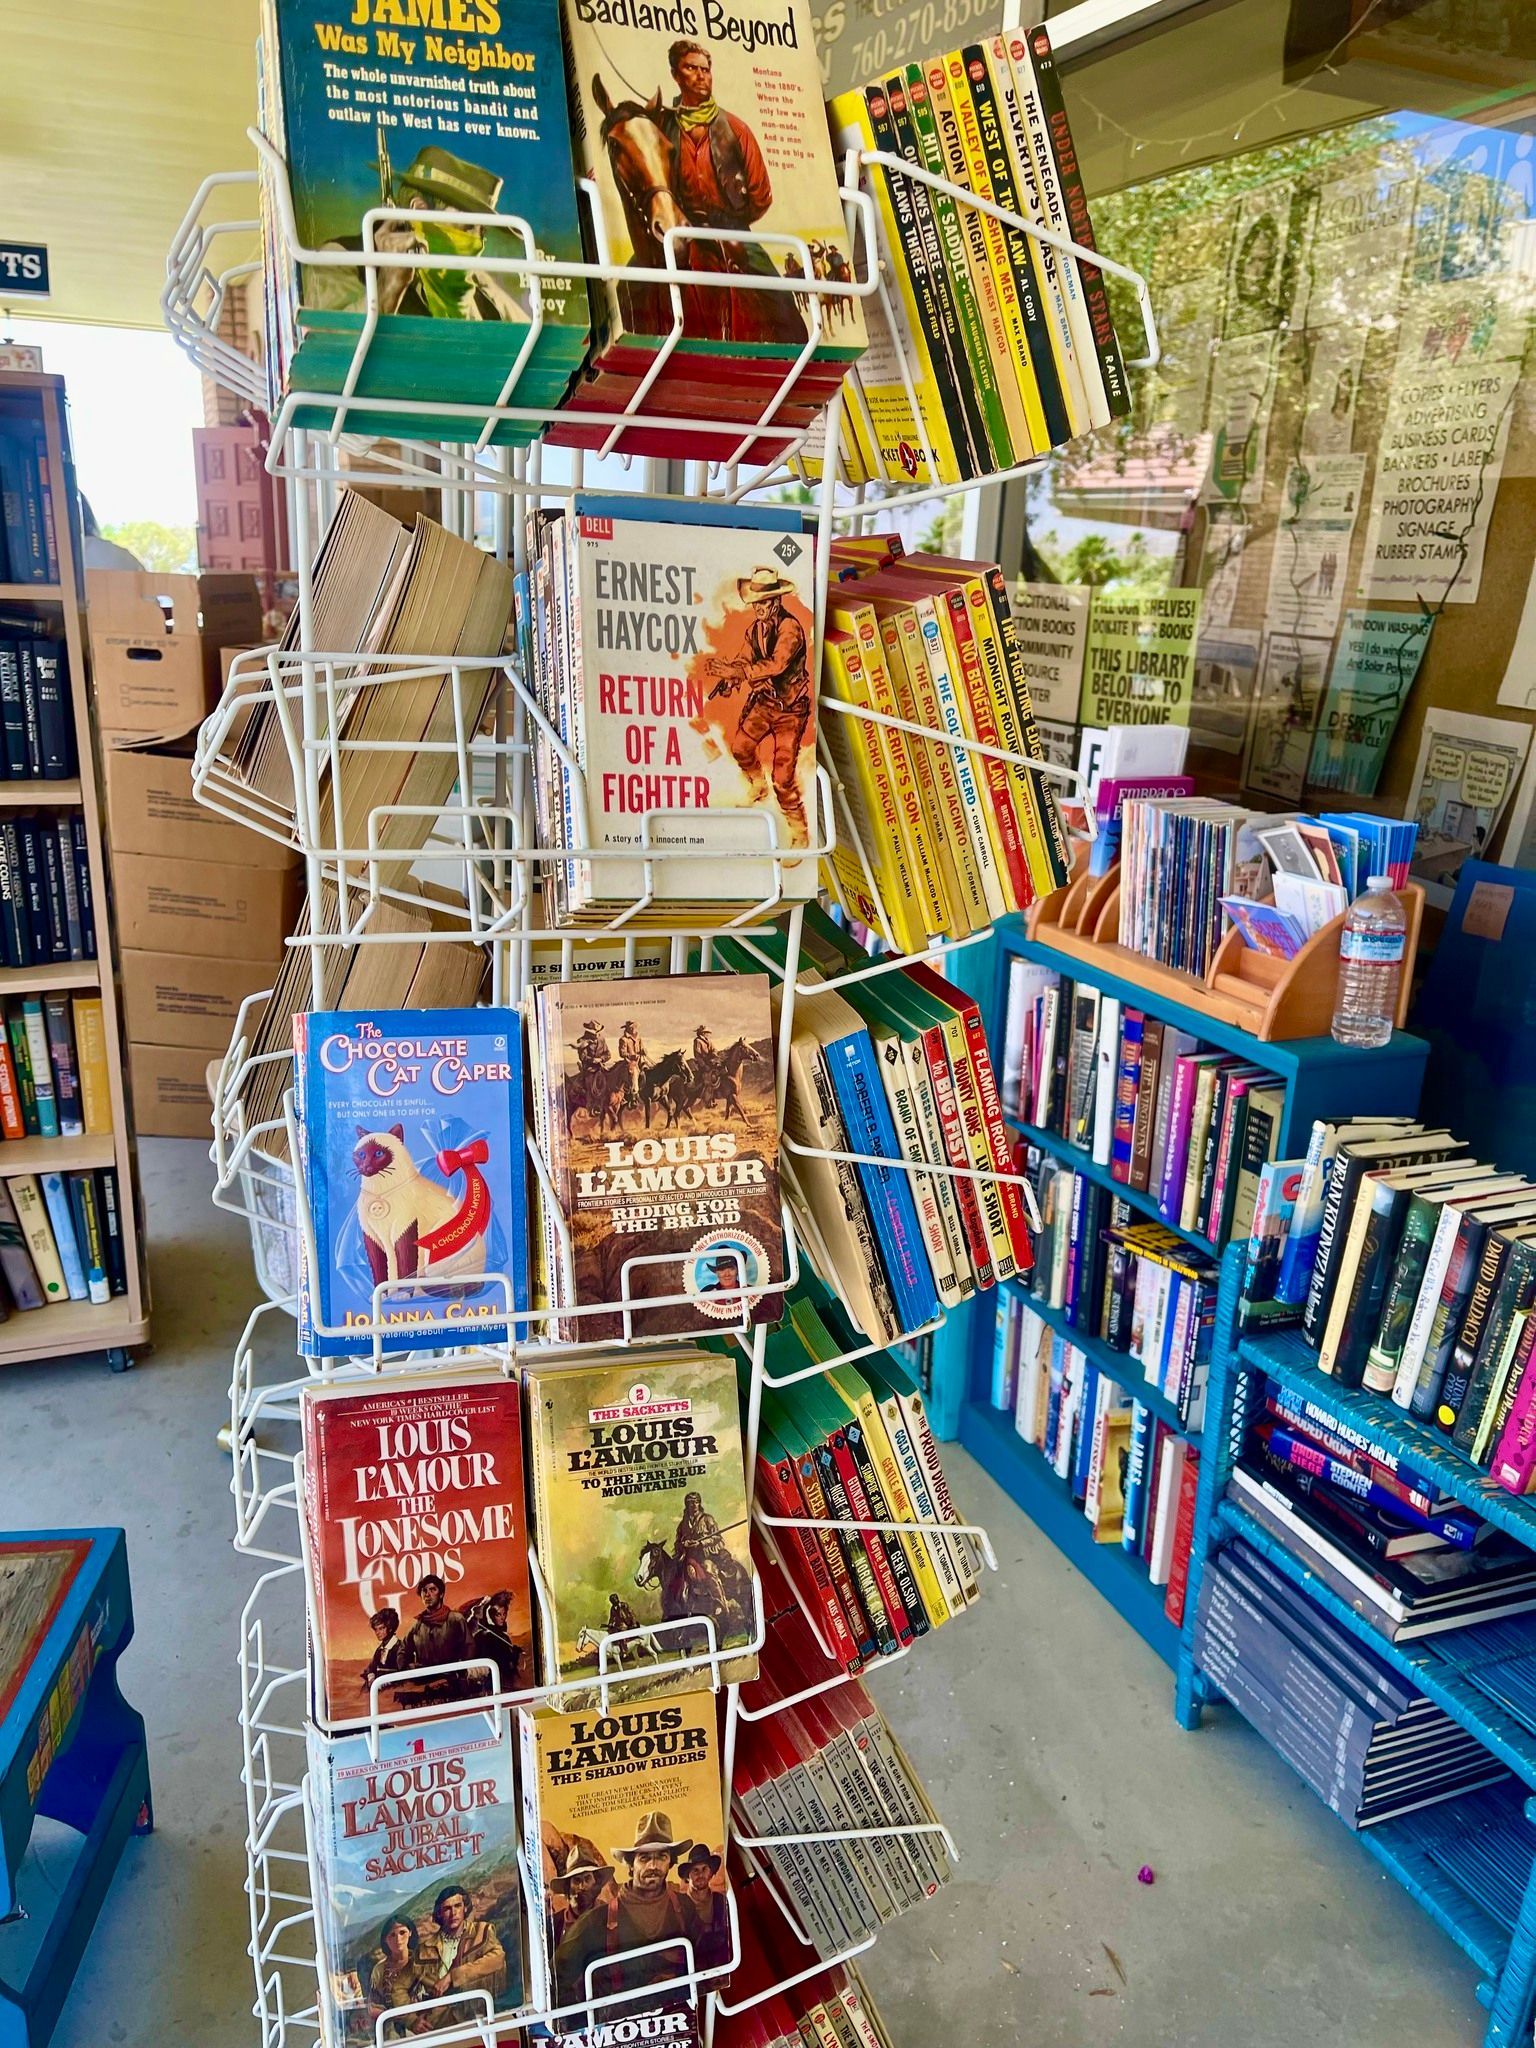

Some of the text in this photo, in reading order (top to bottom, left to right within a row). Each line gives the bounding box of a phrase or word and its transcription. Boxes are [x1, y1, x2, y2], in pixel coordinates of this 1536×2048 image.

[351, 0, 501, 35] JAMES
[576, 0, 798, 53] Badlands Beyond
[314, 24, 536, 72] Was My Neighbor
[323, 63, 536, 99] The whole unvarnished truth about
[753, 67, 782, 77] Montana
[327, 85, 538, 120] the most notorious bandit and
[757, 93, 794, 105] Where the
[328, 107, 541, 141] outlaw the West has ever known.
[959, 100, 980, 156] VALLEY
[979, 101, 1002, 152] WEST
[922, 132, 942, 164] HIT
[939, 110, 966, 175] ACTION
[1023, 90, 1062, 228] THE RENEGADE
[1, 251, 42, 279] TS
[920, 221, 944, 275] THREE
[942, 213, 968, 282] SADDLE
[965, 213, 1008, 356] NIGHT ERNEST HAYCOX
[998, 272, 1015, 304] MEN
[1007, 229, 1037, 322] LAW CODY
[1104, 355, 1122, 398] RAINE
[1401, 377, 1501, 405] COPIES FLYERS
[1404, 403, 1488, 426] ADVERTISING
[1391, 425, 1496, 450] BUSINESS CARDS
[1383, 449, 1495, 472] BANNERS LABELS
[1397, 474, 1471, 494] BROCHURES
[1382, 497, 1478, 516] PHOTOGRAPHY
[586, 517, 611, 535] DELL
[1396, 521, 1456, 538] SIGNAGE
[781, 543, 797, 558] 25¢
[1376, 542, 1469, 560] RUBBER STAMPS
[595, 559, 697, 606] ERNEST
[1142, 598, 1196, 619] SHELVES!
[597, 609, 698, 654] HAYCOX
[1042, 619, 1076, 636] BOOKS
[1092, 619, 1128, 636] DONATE
[1159, 623, 1193, 640] BOOKS
[1350, 619, 1429, 636] WINDOW WASHING
[982, 637, 1008, 708] MIDNIGHT
[1091, 647, 1189, 679] THIS LIBRARY
[600, 674, 704, 718] RETURN
[1162, 680, 1182, 705] TO
[1096, 699, 1171, 725] EVERYONE
[625, 725, 682, 766] OF A
[602, 773, 710, 813] FIGHTER
[876, 773, 896, 827] APACHE
[938, 762, 967, 848] SAN JACINTO
[959, 766, 989, 869] HERD CURT CARROLL
[612, 834, 632, 845] story
[655, 835, 705, 845] innocent man
[0, 862, 12, 901] COLLINS
[355, 1022, 382, 1039] The
[320, 1034, 468, 1073] CHOCOLATE
[367, 1056, 512, 1097] CAT CAPER
[5, 1094, 18, 1129] OPINION
[954, 1057, 981, 1138] BOUNTY GUNS
[974, 1050, 1010, 1167] FLAMING IRONS
[935, 1078, 965, 1164] BIG FIST
[604, 1133, 737, 1168] LOUIS
[576, 1159, 767, 1198] L'AMOUR
[611, 1198, 741, 1222] RIDING FOR
[612, 1211, 741, 1234] THE BRAND
[982, 1197, 1005, 1237] SHORT
[708, 1232, 764, 1258] AUTHORIZED EDITION
[1461, 1238, 1504, 1349] DAVID BALDACCI
[1449, 1375, 1468, 1409] STONE
[350, 1405, 496, 1428] NEW YORK TIMES HARDCOVER LIST
[593, 1401, 690, 1421] THE SACKETTS
[375, 1416, 472, 1461] LOUIS
[589, 1417, 695, 1448] LOUIS
[1305, 1401, 1400, 1472] HOWARD AIRLINE
[567, 1435, 719, 1472] L'AMOUR
[1290, 1453, 1323, 1477] SIEGE
[1291, 1441, 1326, 1467] UNDER
[353, 1451, 501, 1502] L'AMOUR
[581, 1464, 706, 1490] TO THE FAR BLUE
[601, 1478, 688, 1498] MOUNTAINS
[881, 1457, 908, 1514] GENTLE ANNIE
[918, 1428, 956, 1522] PROUD DIGGERS
[1330, 1461, 1373, 1490] STEPHEN
[1331, 1472, 1368, 1498] COONTS
[397, 1494, 436, 1516] THE
[334, 1503, 515, 1586] LONESOME
[359, 1548, 465, 1625] GODS
[890, 1551, 919, 1609] GENE OLSON
[875, 1608, 889, 1631] FOX
[570, 1708, 683, 1745] LOUIS
[547, 1727, 709, 1773] L'AMOUR
[366, 1758, 467, 1804] LOUIS
[551, 1750, 707, 1786] THE SHADOW RIDERS
[851, 1768, 874, 1807] SHERIFF
[342, 1778, 500, 1838] L'AMOUR
[382, 1816, 468, 1855] JUBAL
[366, 1832, 486, 1882] SACKETT
[791, 1876, 811, 1909] OUTLAW
